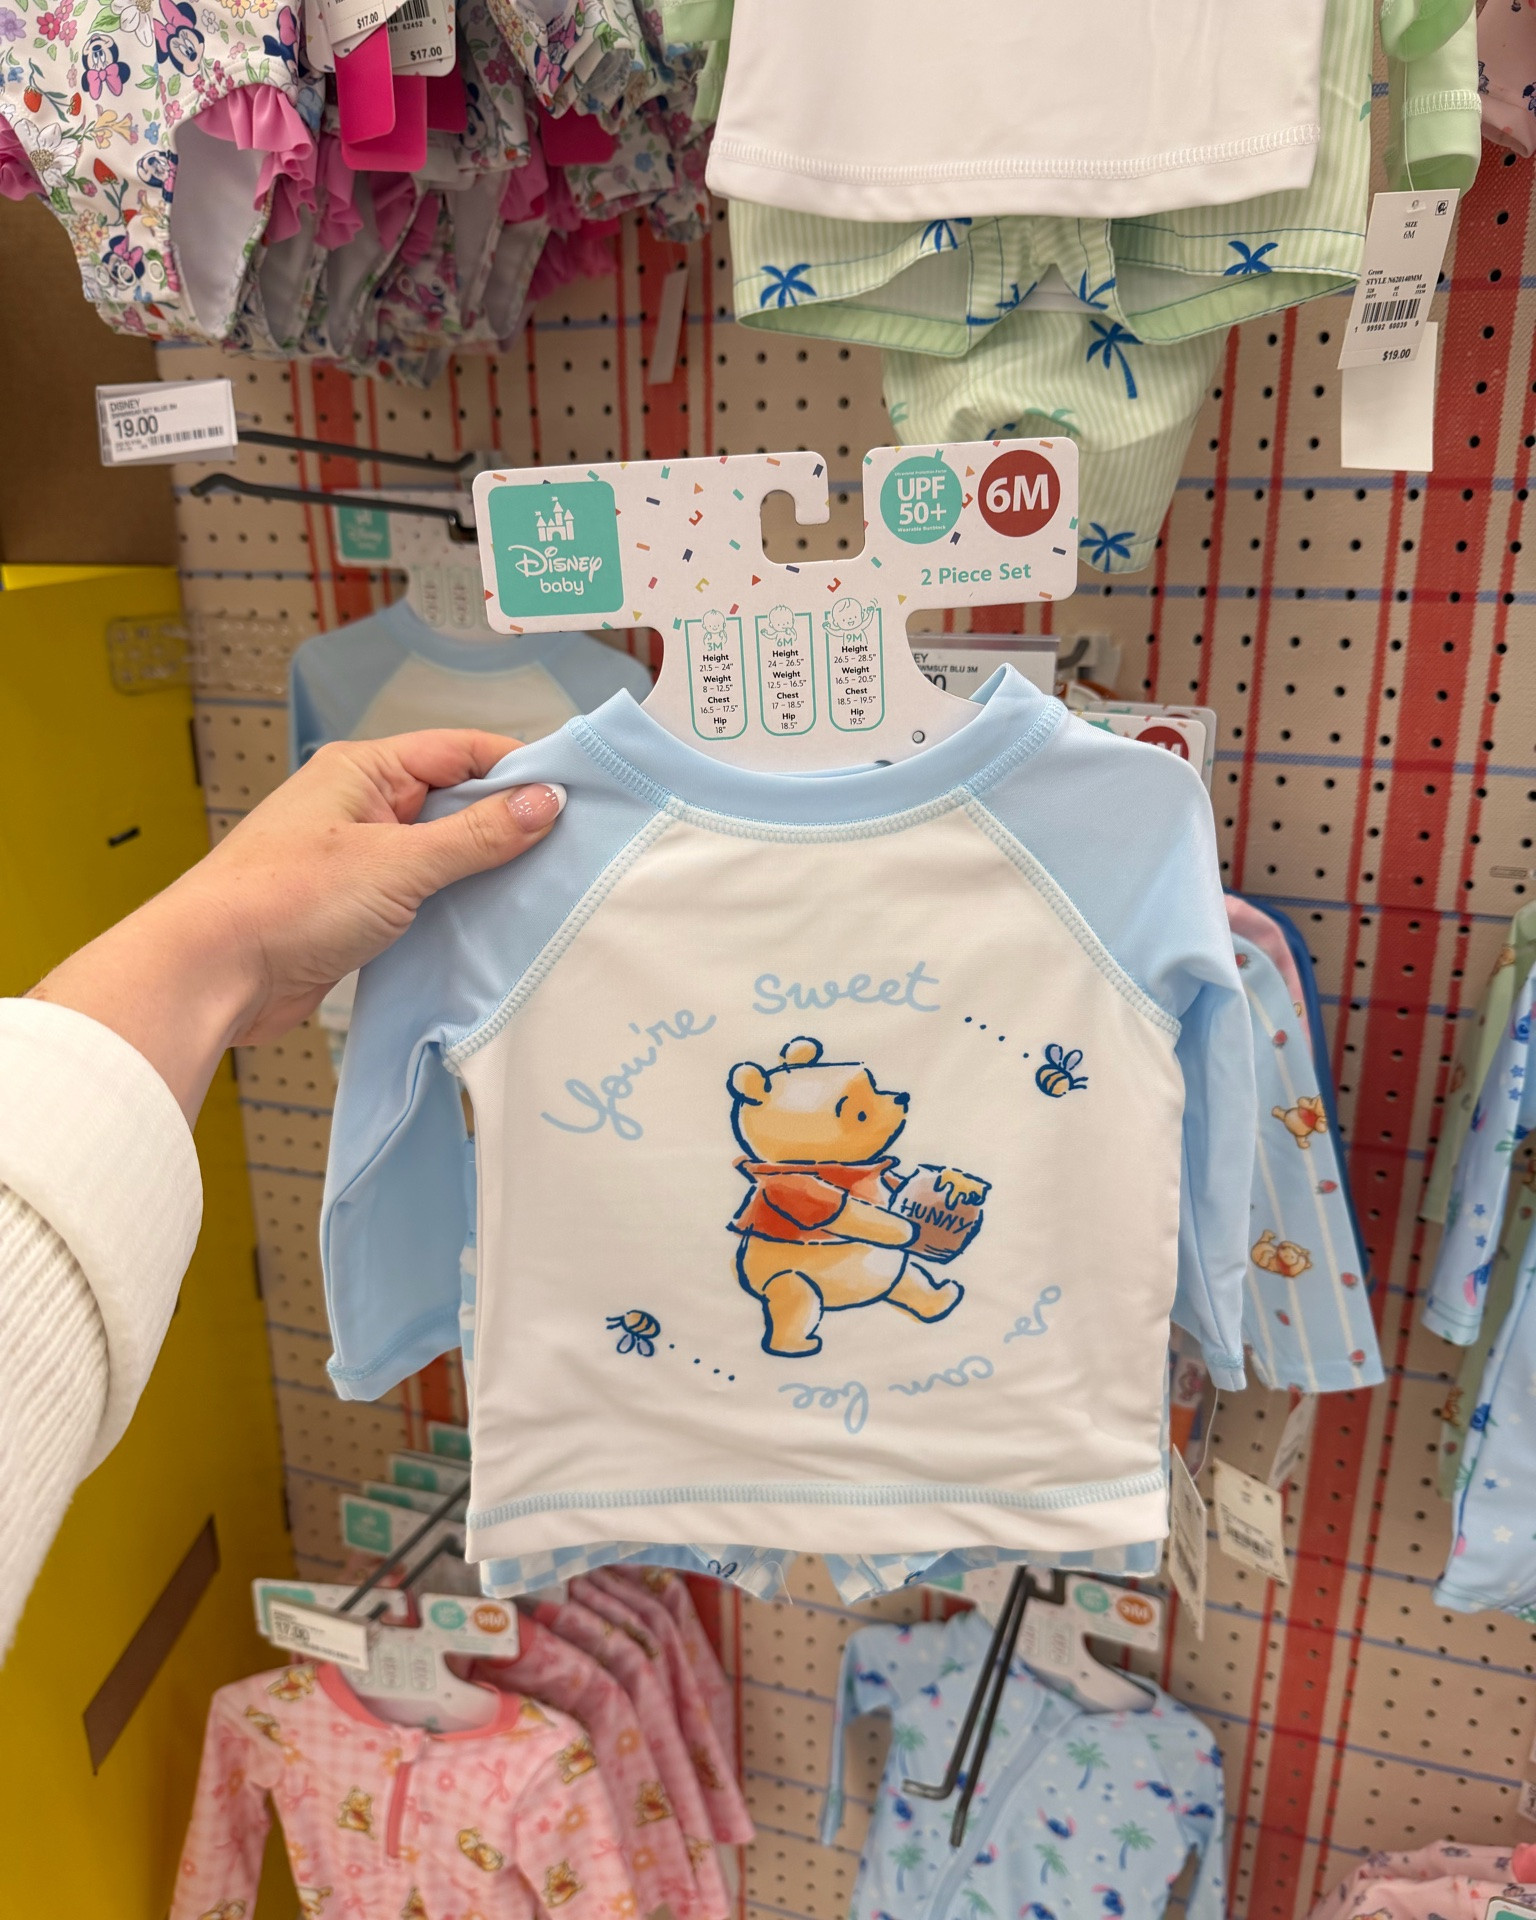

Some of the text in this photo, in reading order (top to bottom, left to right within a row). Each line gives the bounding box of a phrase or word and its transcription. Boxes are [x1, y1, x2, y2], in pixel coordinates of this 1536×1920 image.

[357, 11, 379, 29] $17.00
[410, 46, 442, 61] $17.00
[1404, 220, 1418, 228] SIZE
[1403, 230, 1416, 239] 6M
[1366, 277, 1387, 285] STYLE
[1366, 323, 1385, 332] 99592
[1389, 321, 1407, 330] 60039
[1382, 348, 1411, 361] $19.00
[110, 399, 140, 412] DISNEY
[114, 415, 159, 439] 19.00
[897, 476, 945, 501] UPF
[986, 473, 1050, 513] 6M
[899, 502, 947, 525] 50+
[921, 563, 1032, 586] 2 Piece Set
[540, 577, 584, 595] baby
[777, 638, 792, 646] 6M
[846, 634, 862, 642] 9M
[707, 642, 722, 651] 3M
[842, 645, 868, 654] Height
[703, 654, 729, 662] Height
[773, 650, 798, 658] Height
[912, 653, 928, 663] EY
[842, 666, 869, 675] Weight
[917, 664, 948, 672] WMSUT
[950, 665, 965, 673] BLU
[703, 676, 731, 684] Weight
[773, 671, 800, 679] Weight
[714, 717, 727, 725] Hip
[782, 713, 795, 721] Hip
[541, 1009, 717, 1140] You're
[901, 1198, 974, 1234] HUNNY
[888, 1355, 995, 1396] can
[777, 1381, 870, 1435] bee
